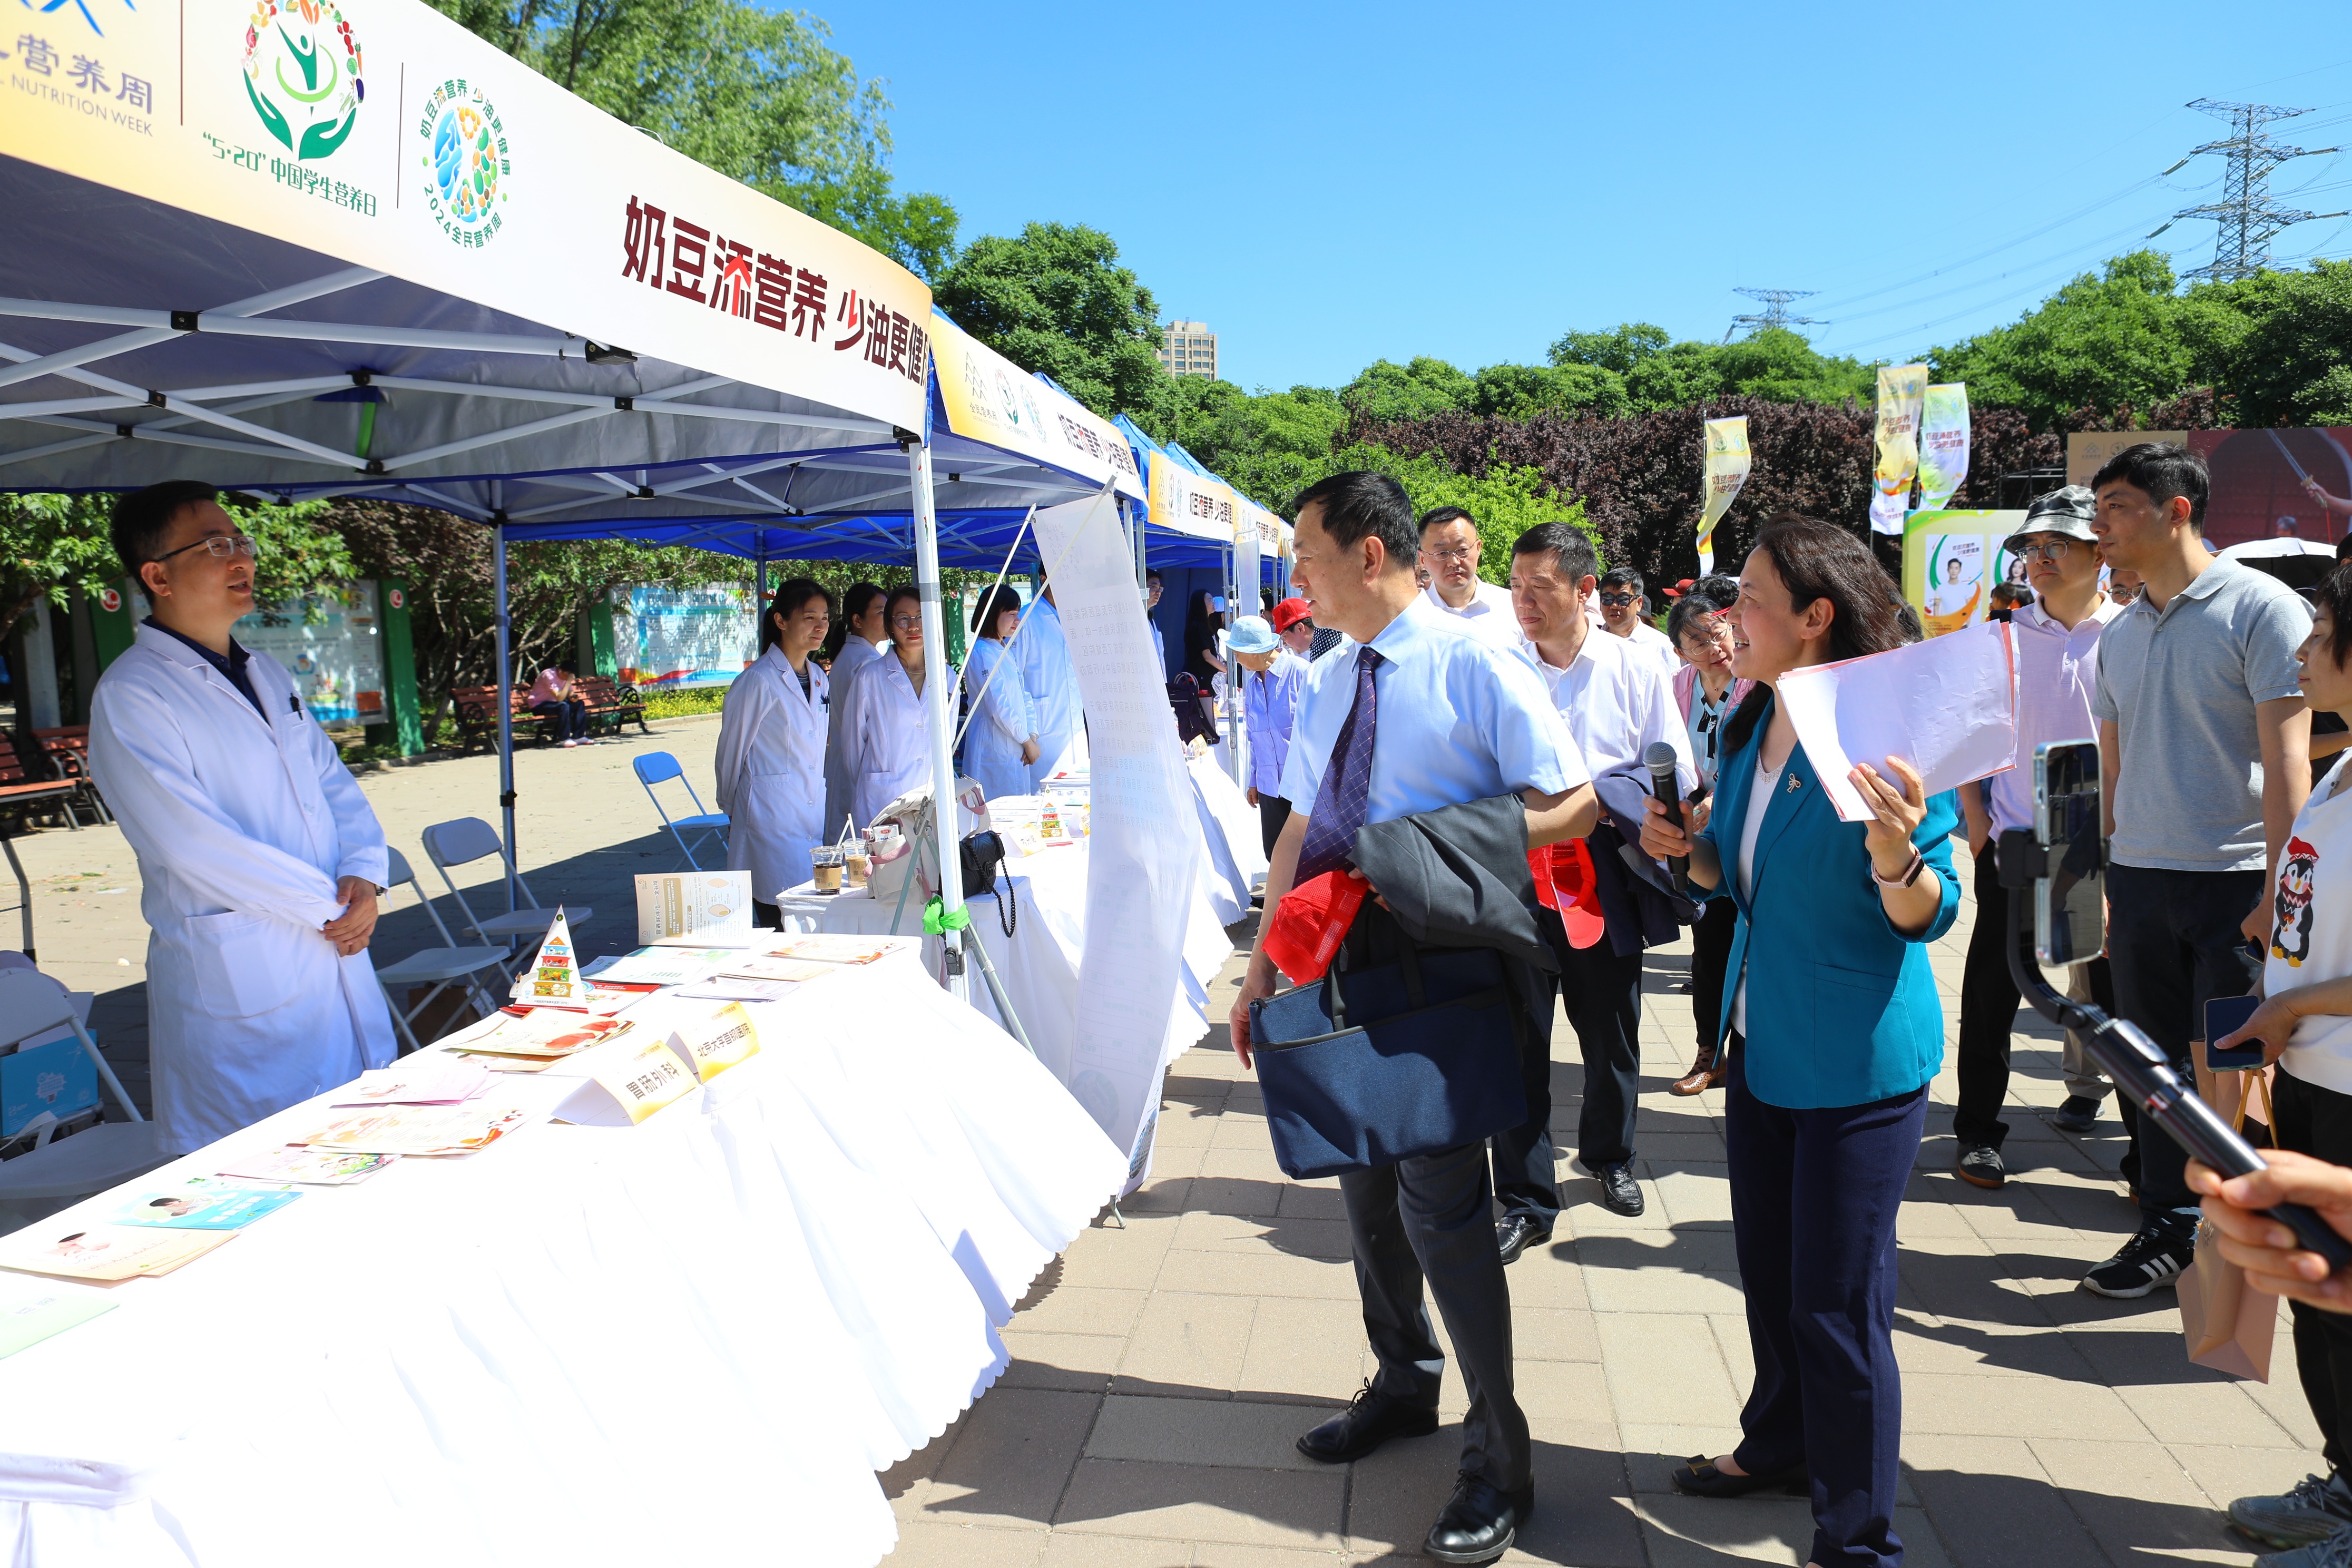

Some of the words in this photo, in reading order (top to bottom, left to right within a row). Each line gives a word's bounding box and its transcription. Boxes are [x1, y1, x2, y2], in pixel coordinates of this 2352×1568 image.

[0, 33, 152, 115] 营养周
[12, 73, 107, 121] NUTRITION
[111, 109, 153, 138] WEEK
[621, 194, 828, 343] 奶豆添营养
[1057, 411, 1106, 462] 奶豆添营养
[1214, 498, 1233, 525] 少油更健
[697, 1023, 751, 1057] 北京大学首钢医院
[625, 1061, 680, 1101] 胃肠外科
